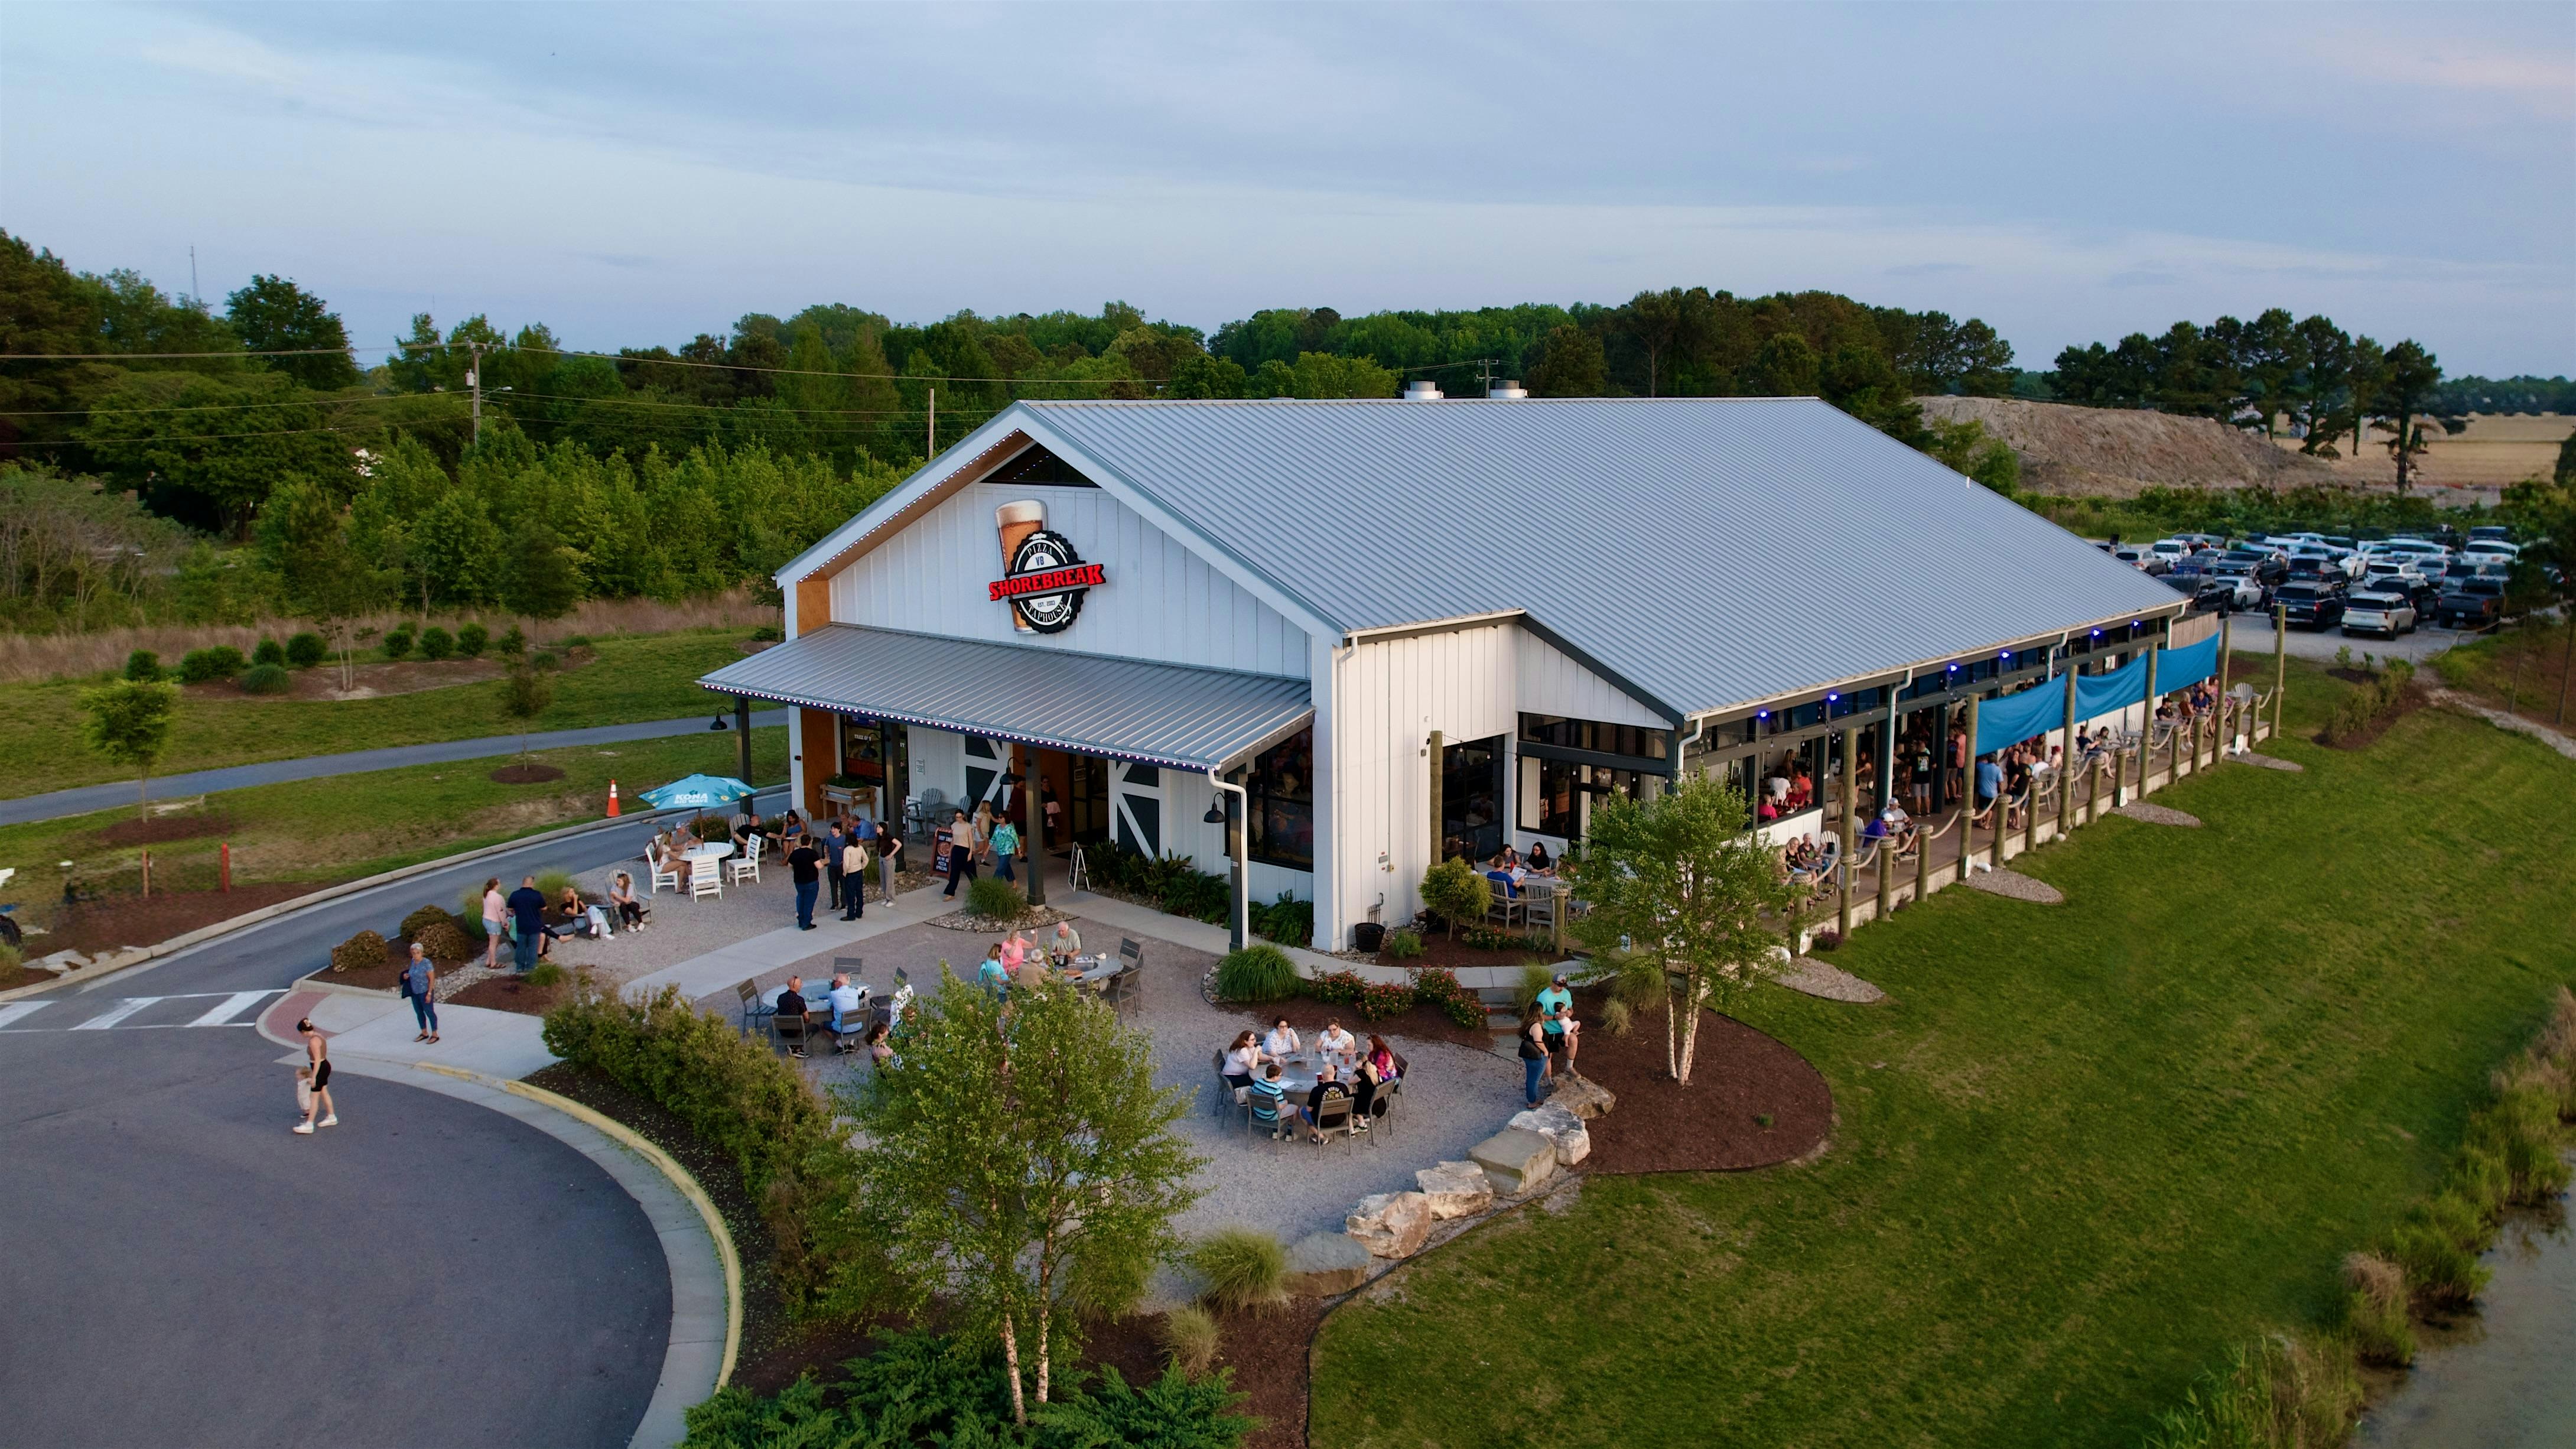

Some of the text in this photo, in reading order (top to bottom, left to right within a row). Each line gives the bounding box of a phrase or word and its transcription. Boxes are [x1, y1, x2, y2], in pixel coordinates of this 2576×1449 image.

[1027, 544, 1052, 557] PIZZA
[989, 564, 1105, 601] SHOREBREAK
[1028, 600, 1066, 622] TAPHOUSE
